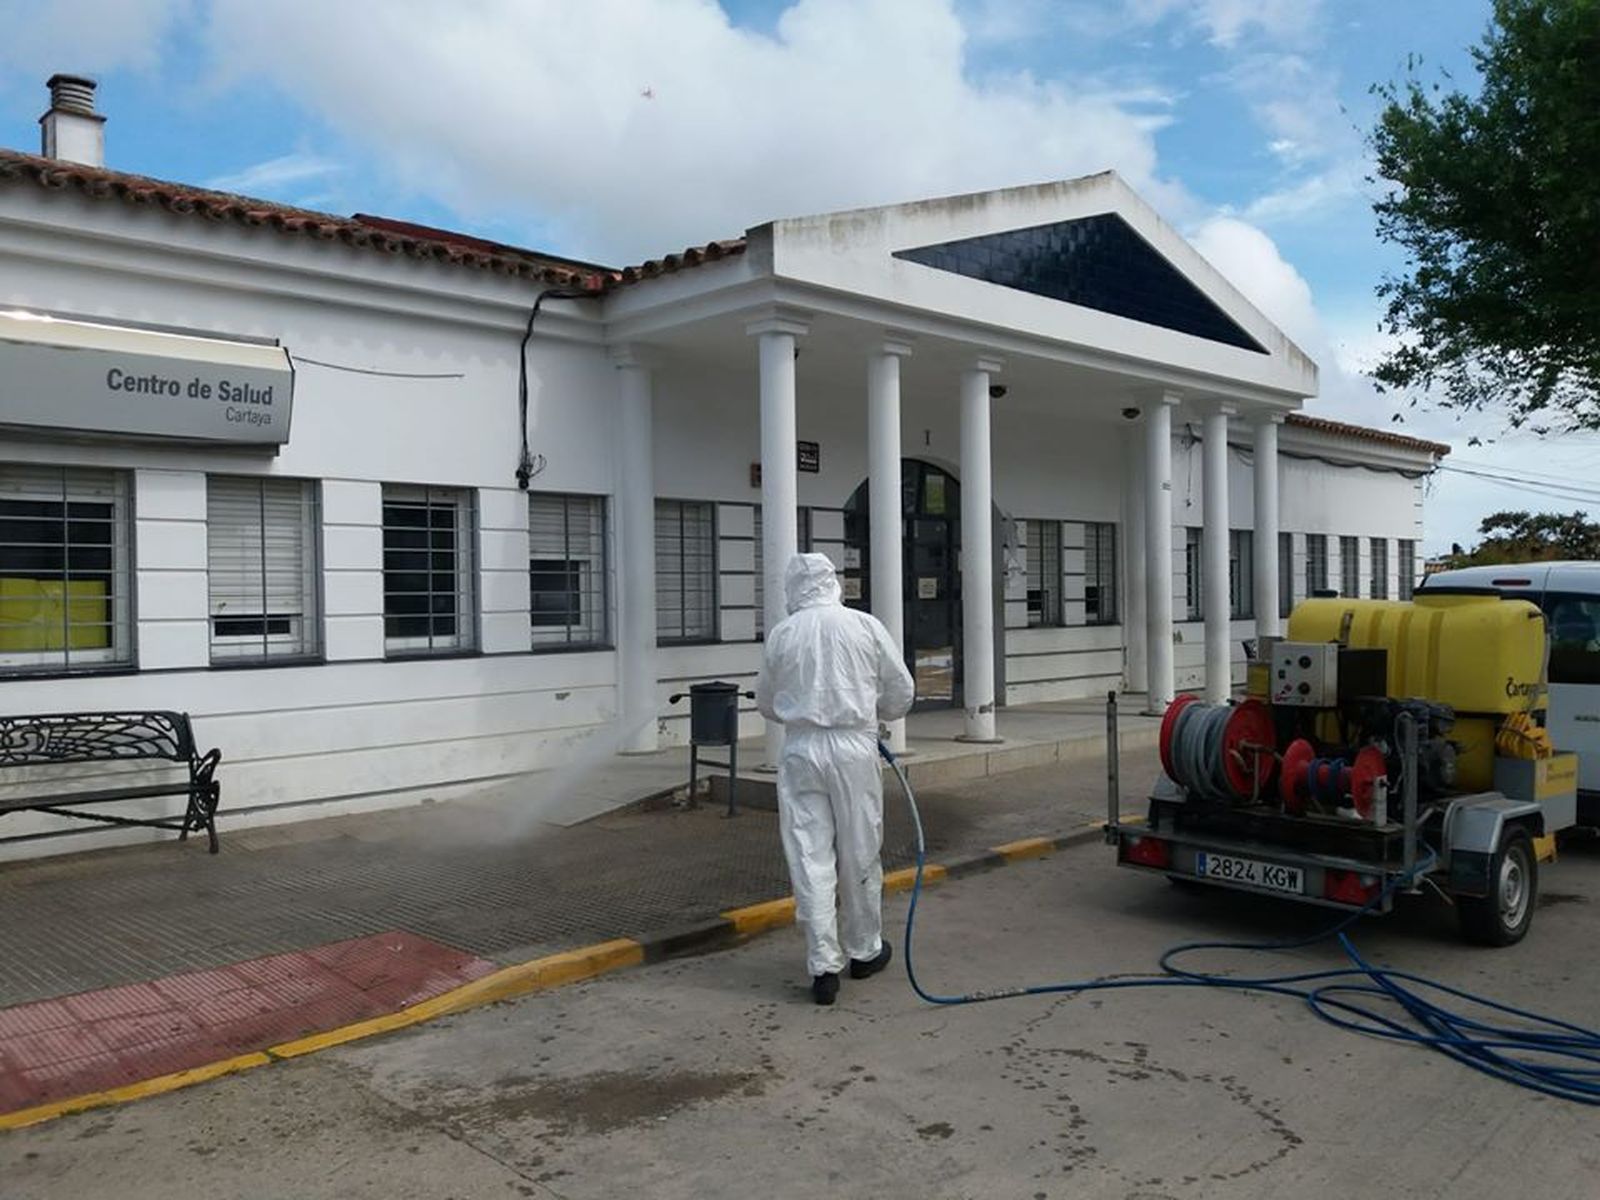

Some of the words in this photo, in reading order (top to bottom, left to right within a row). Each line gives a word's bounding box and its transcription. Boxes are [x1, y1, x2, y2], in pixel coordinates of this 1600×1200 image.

[107, 368, 181, 396] Centro
[187, 378, 212, 399] de
[218, 380, 273, 405] Salud
[225, 406, 272, 427] Cartaya
[1210, 856, 1256, 881] 2824
[1262, 865, 1298, 889] KGW
